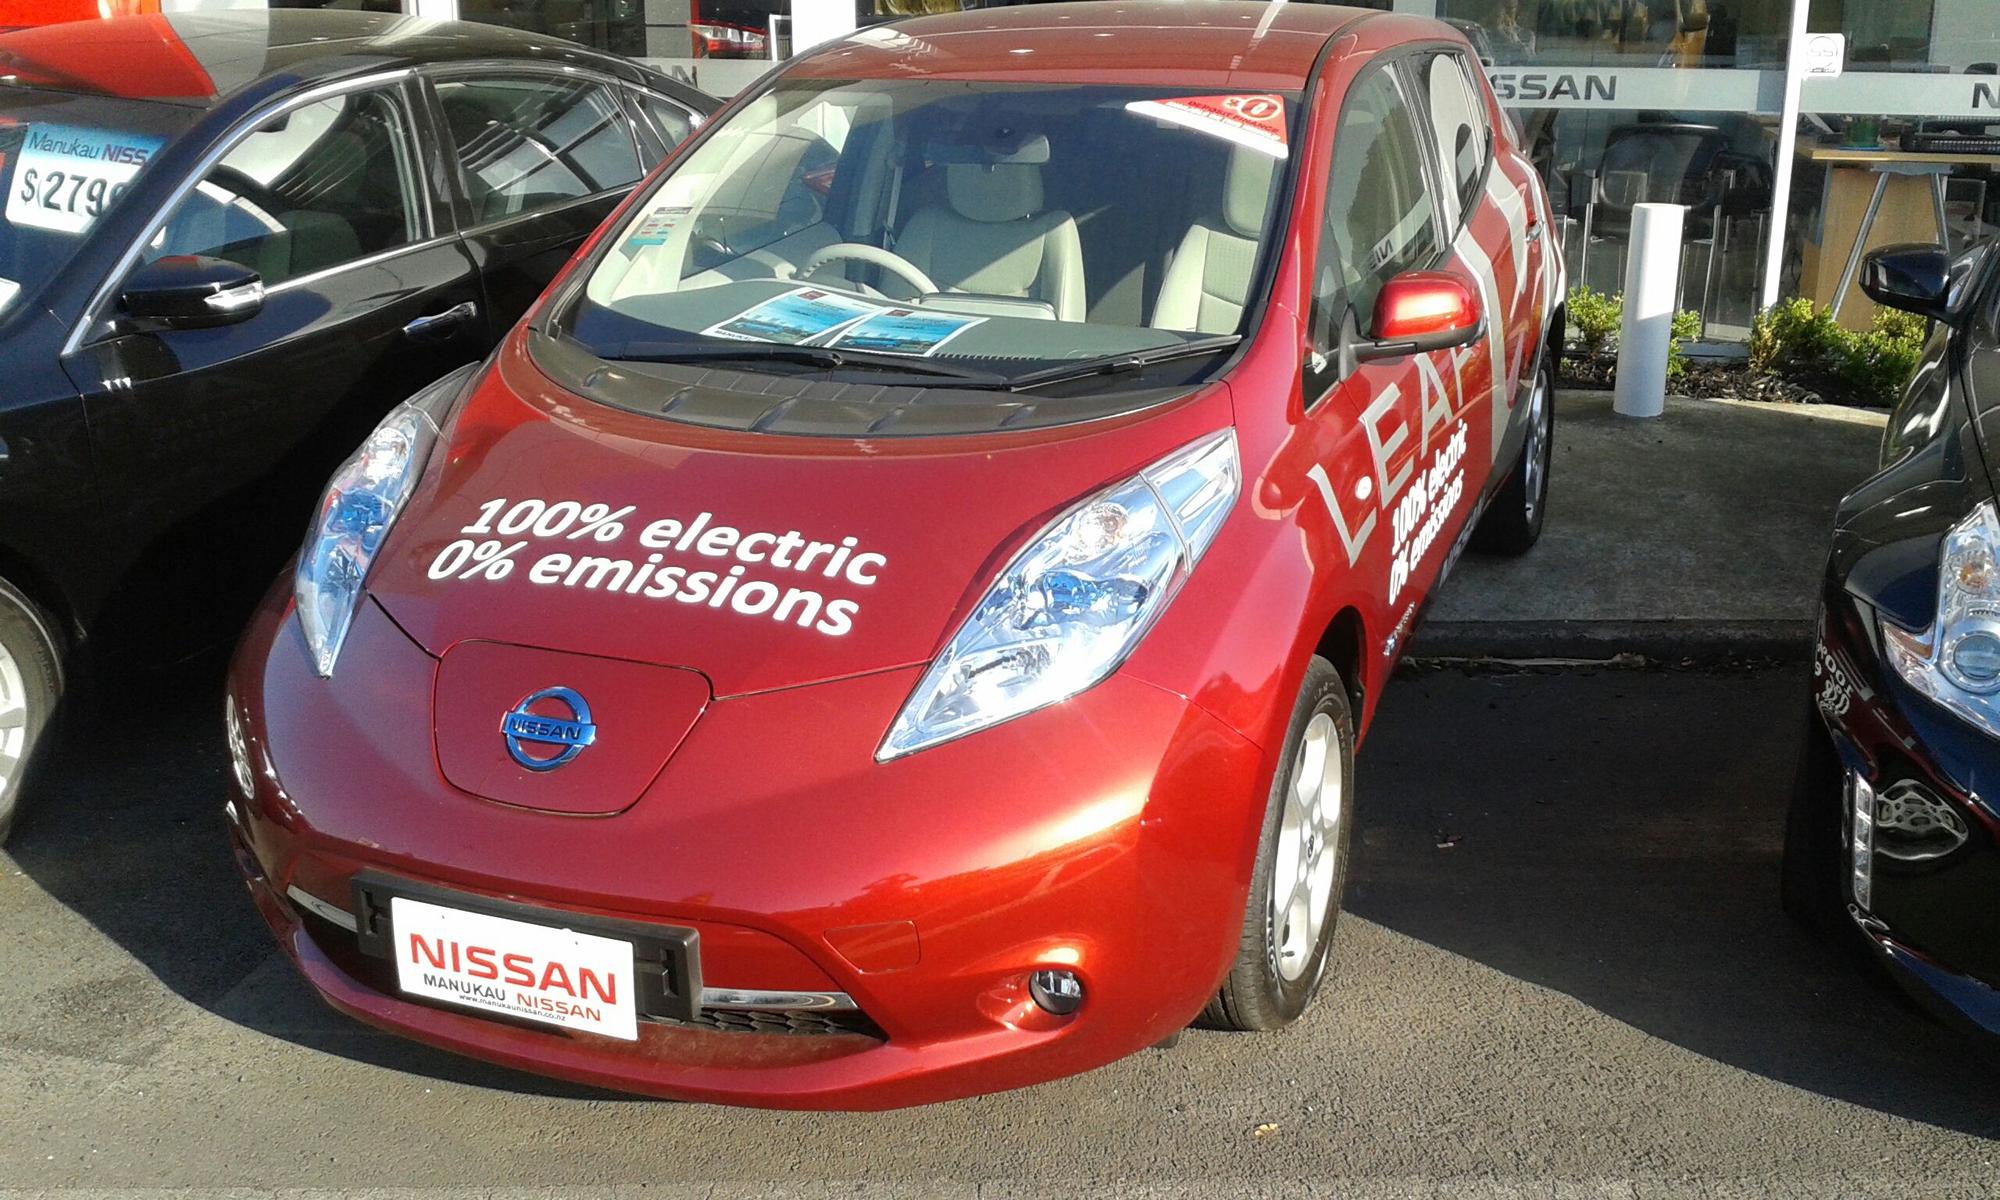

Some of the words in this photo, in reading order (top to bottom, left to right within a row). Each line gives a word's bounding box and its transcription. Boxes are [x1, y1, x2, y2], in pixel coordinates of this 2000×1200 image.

[29, 131, 101, 159] Manukau
[1188, 101, 1233, 118] DEPOSIT
[1232, 114, 1281, 134] FINANCE
[1391, 469, 1427, 556] 100%
[1428, 418, 1467, 501] electric
[461, 498, 637, 542] 100%
[639, 512, 887, 585] electric
[1389, 540, 1409, 606] 0%
[1410, 468, 1464, 571] emissions
[427, 539, 528, 582] 0%
[528, 553, 860, 636] emissions
[507, 717, 582, 741] NISSAN
[410, 932, 617, 1006] NISSAN
[423, 973, 506, 1002] MANUKAU
[516, 992, 601, 1022] NISSAN
[459, 994, 566, 1022] www.manukaunissan.co.nz
